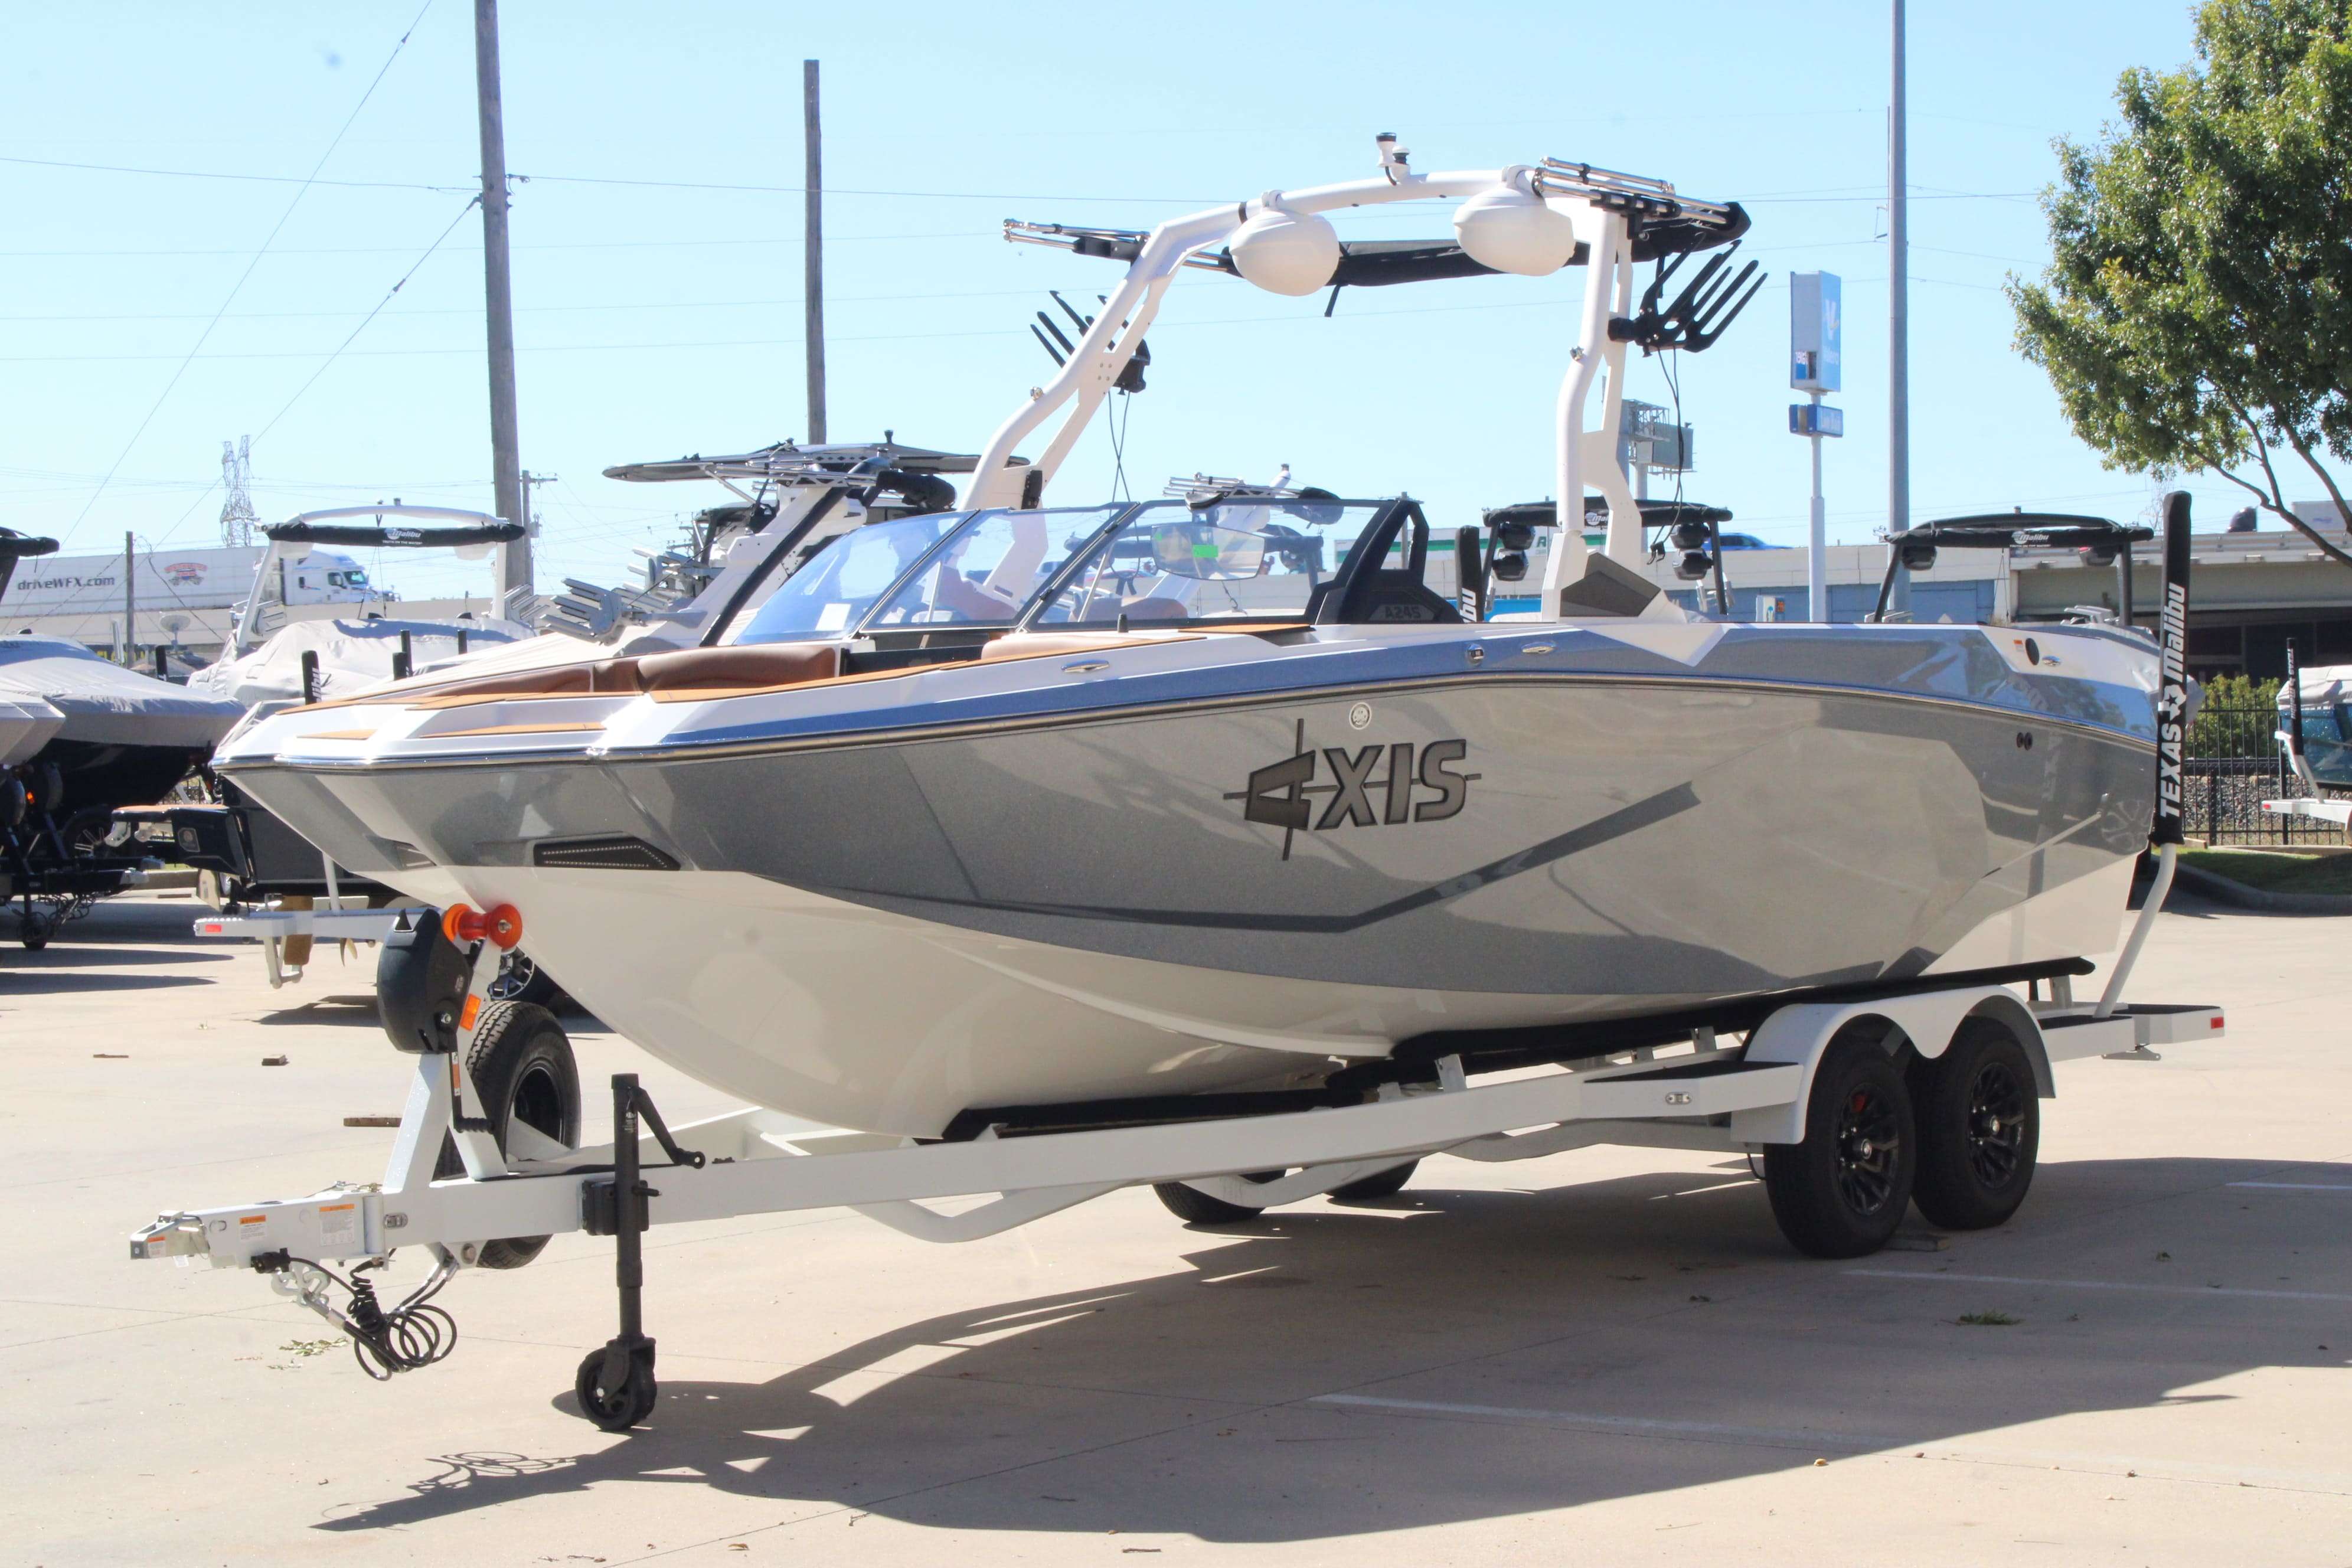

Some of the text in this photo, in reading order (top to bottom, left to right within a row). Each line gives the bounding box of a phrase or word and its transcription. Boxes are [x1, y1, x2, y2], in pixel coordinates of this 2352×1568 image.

[18, 577, 115, 590] driveWFX.com
[2160, 582, 2185, 818] TEXAS Malibu
[1243, 738, 1468, 831] AXIS
